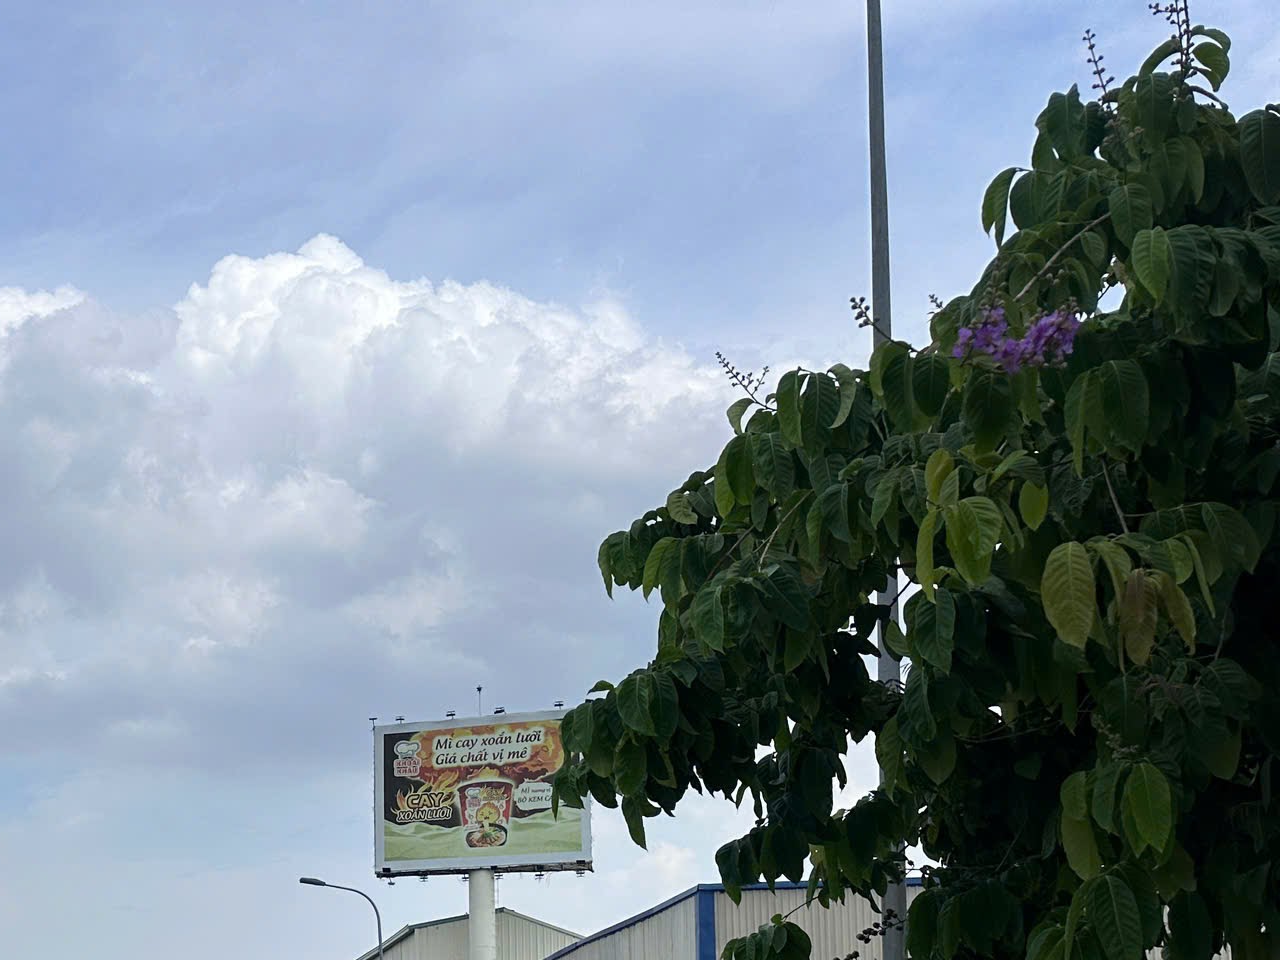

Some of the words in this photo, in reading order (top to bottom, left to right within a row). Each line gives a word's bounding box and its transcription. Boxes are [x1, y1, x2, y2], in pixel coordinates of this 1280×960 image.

[435, 738, 452, 750] Mì
[456, 738, 478, 750] cay
[481, 731, 512, 745] xoắn
[516, 730, 542, 743] lưỡi
[435, 752, 457, 765] Giá
[461, 748, 488, 763] chất
[493, 749, 504, 762] vị
[507, 747, 528, 760] mê
[407, 791, 444, 809] CAY
